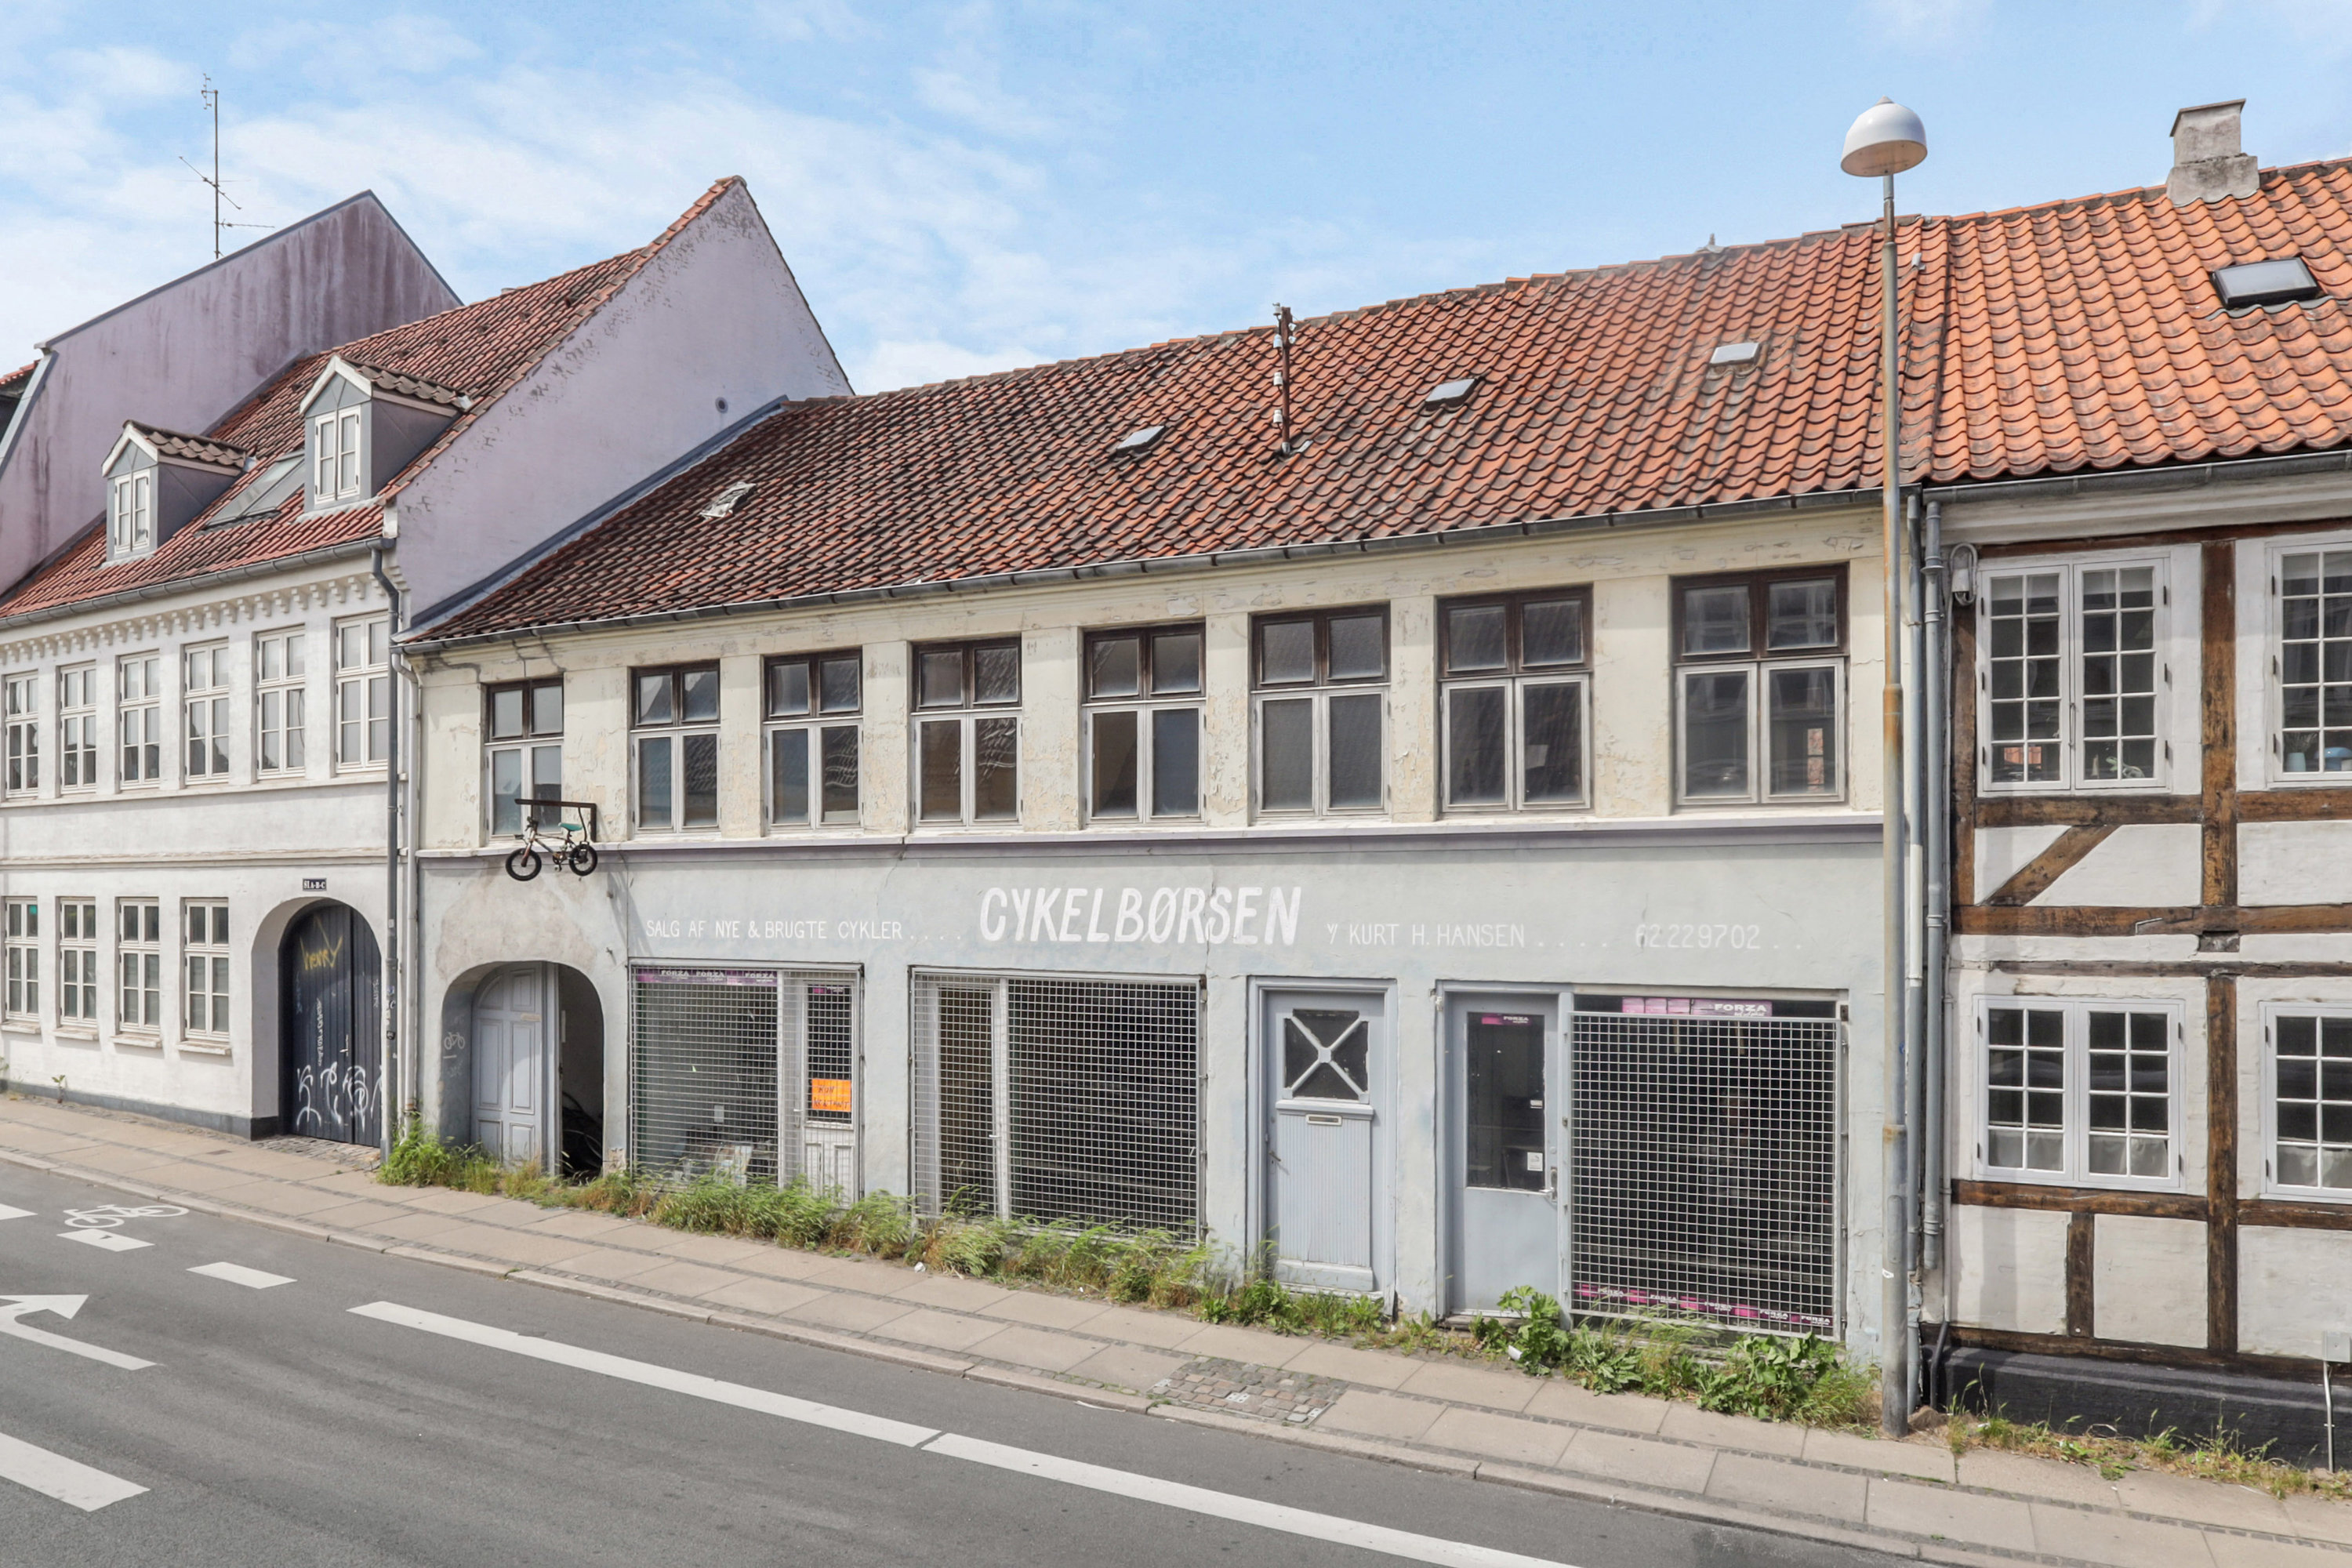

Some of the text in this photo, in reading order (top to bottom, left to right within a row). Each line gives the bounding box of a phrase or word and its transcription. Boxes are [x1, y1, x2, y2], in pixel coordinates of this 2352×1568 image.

[980, 887, 1301, 946] CYKELBØRSEN
[646, 920, 902, 940] SALG AF NYE & BRUGTE CYKLER
[1349, 924, 1399, 945] KURT
[1412, 924, 1430, 946] H.
[1437, 924, 1525, 948] HANSEN
[1715, 1004, 1767, 1012] FORZA
